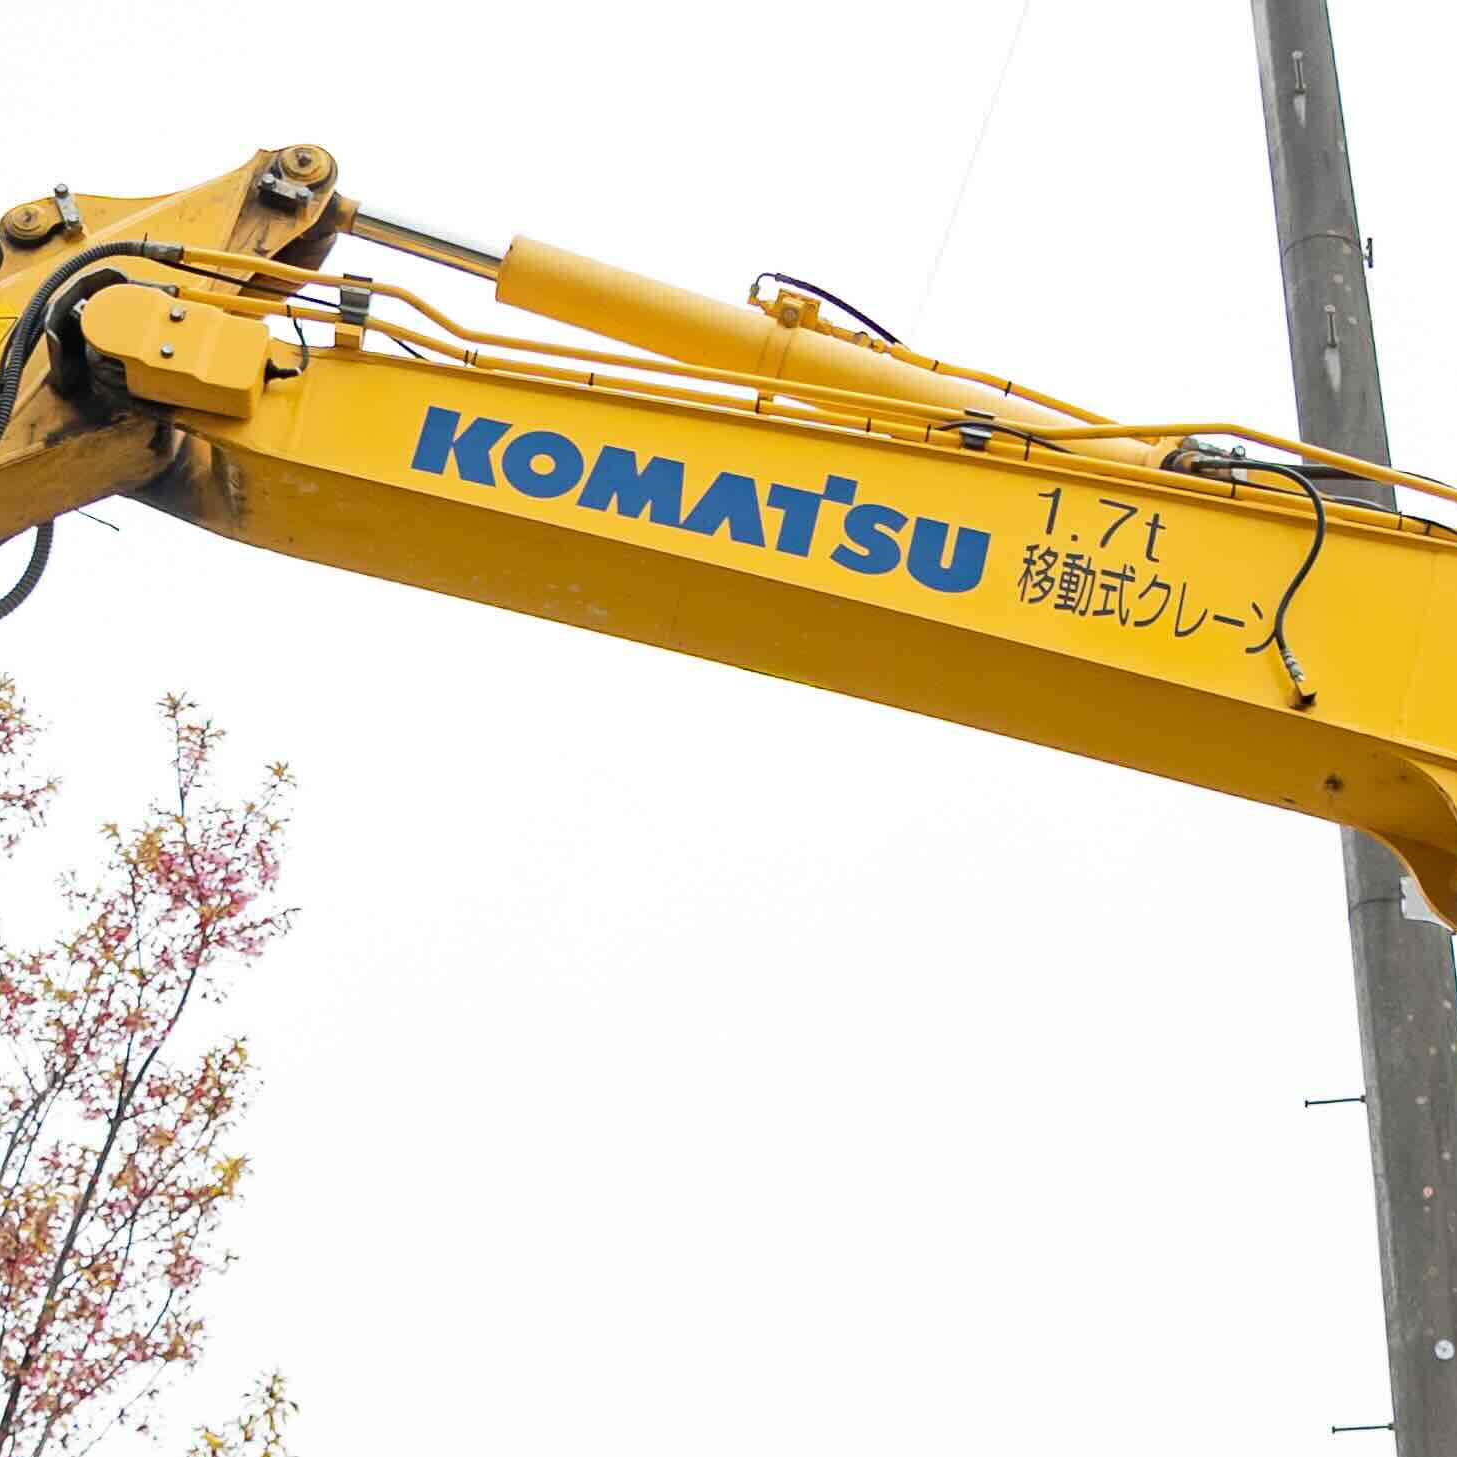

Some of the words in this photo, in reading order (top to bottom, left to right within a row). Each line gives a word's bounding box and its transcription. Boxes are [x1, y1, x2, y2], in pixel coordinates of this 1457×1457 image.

[409, 405, 992, 595] KOMATSU
[1037, 486, 1167, 563] 1.7t
[1016, 543, 1279, 654] 移動式クレーン
